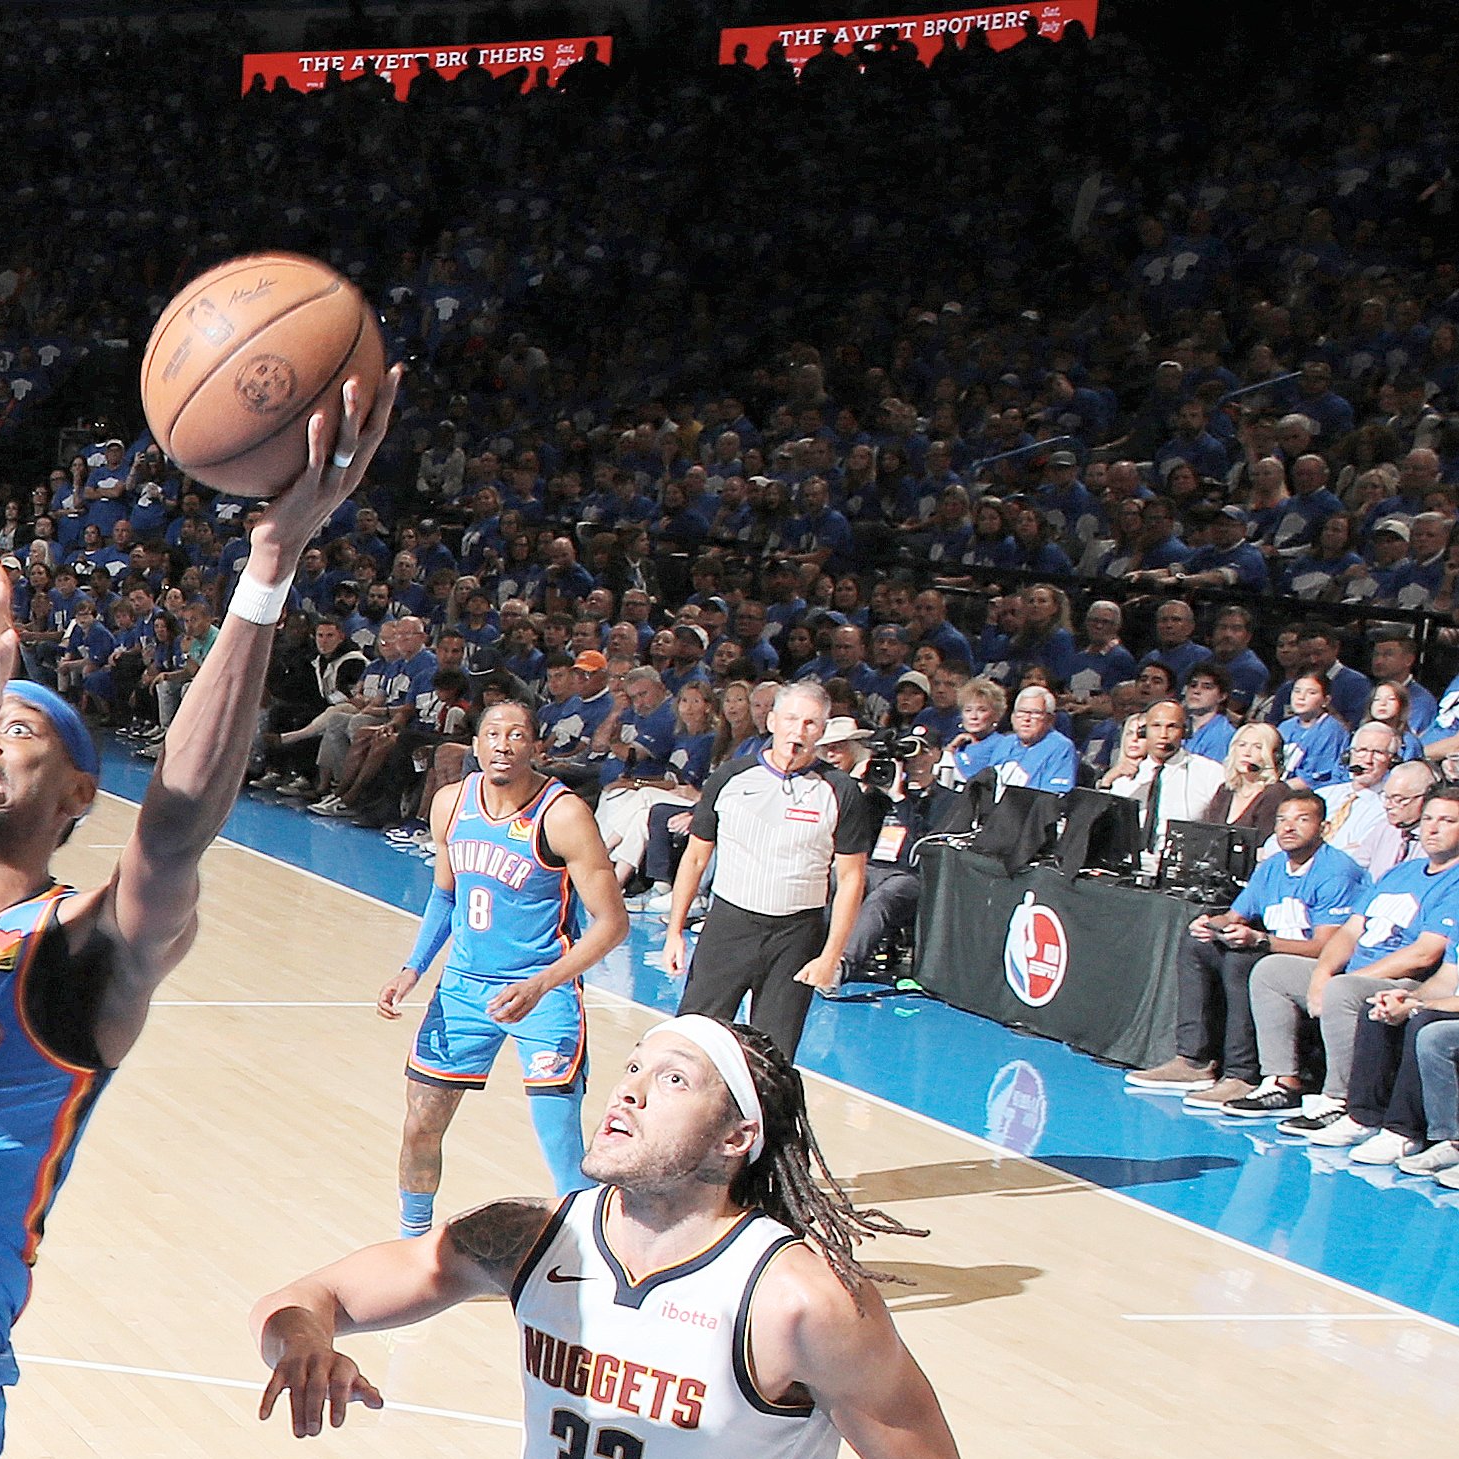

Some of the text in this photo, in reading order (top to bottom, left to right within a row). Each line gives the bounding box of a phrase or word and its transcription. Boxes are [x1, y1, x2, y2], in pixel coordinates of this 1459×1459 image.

[779, 28, 831, 47] THE
[298, 54, 345, 73] THE
[447, 840, 534, 892] THUNDER
[467, 886, 492, 932] 8
[661, 1301, 719, 1330] ibotta
[523, 1324, 708, 1431] NUGGETS
